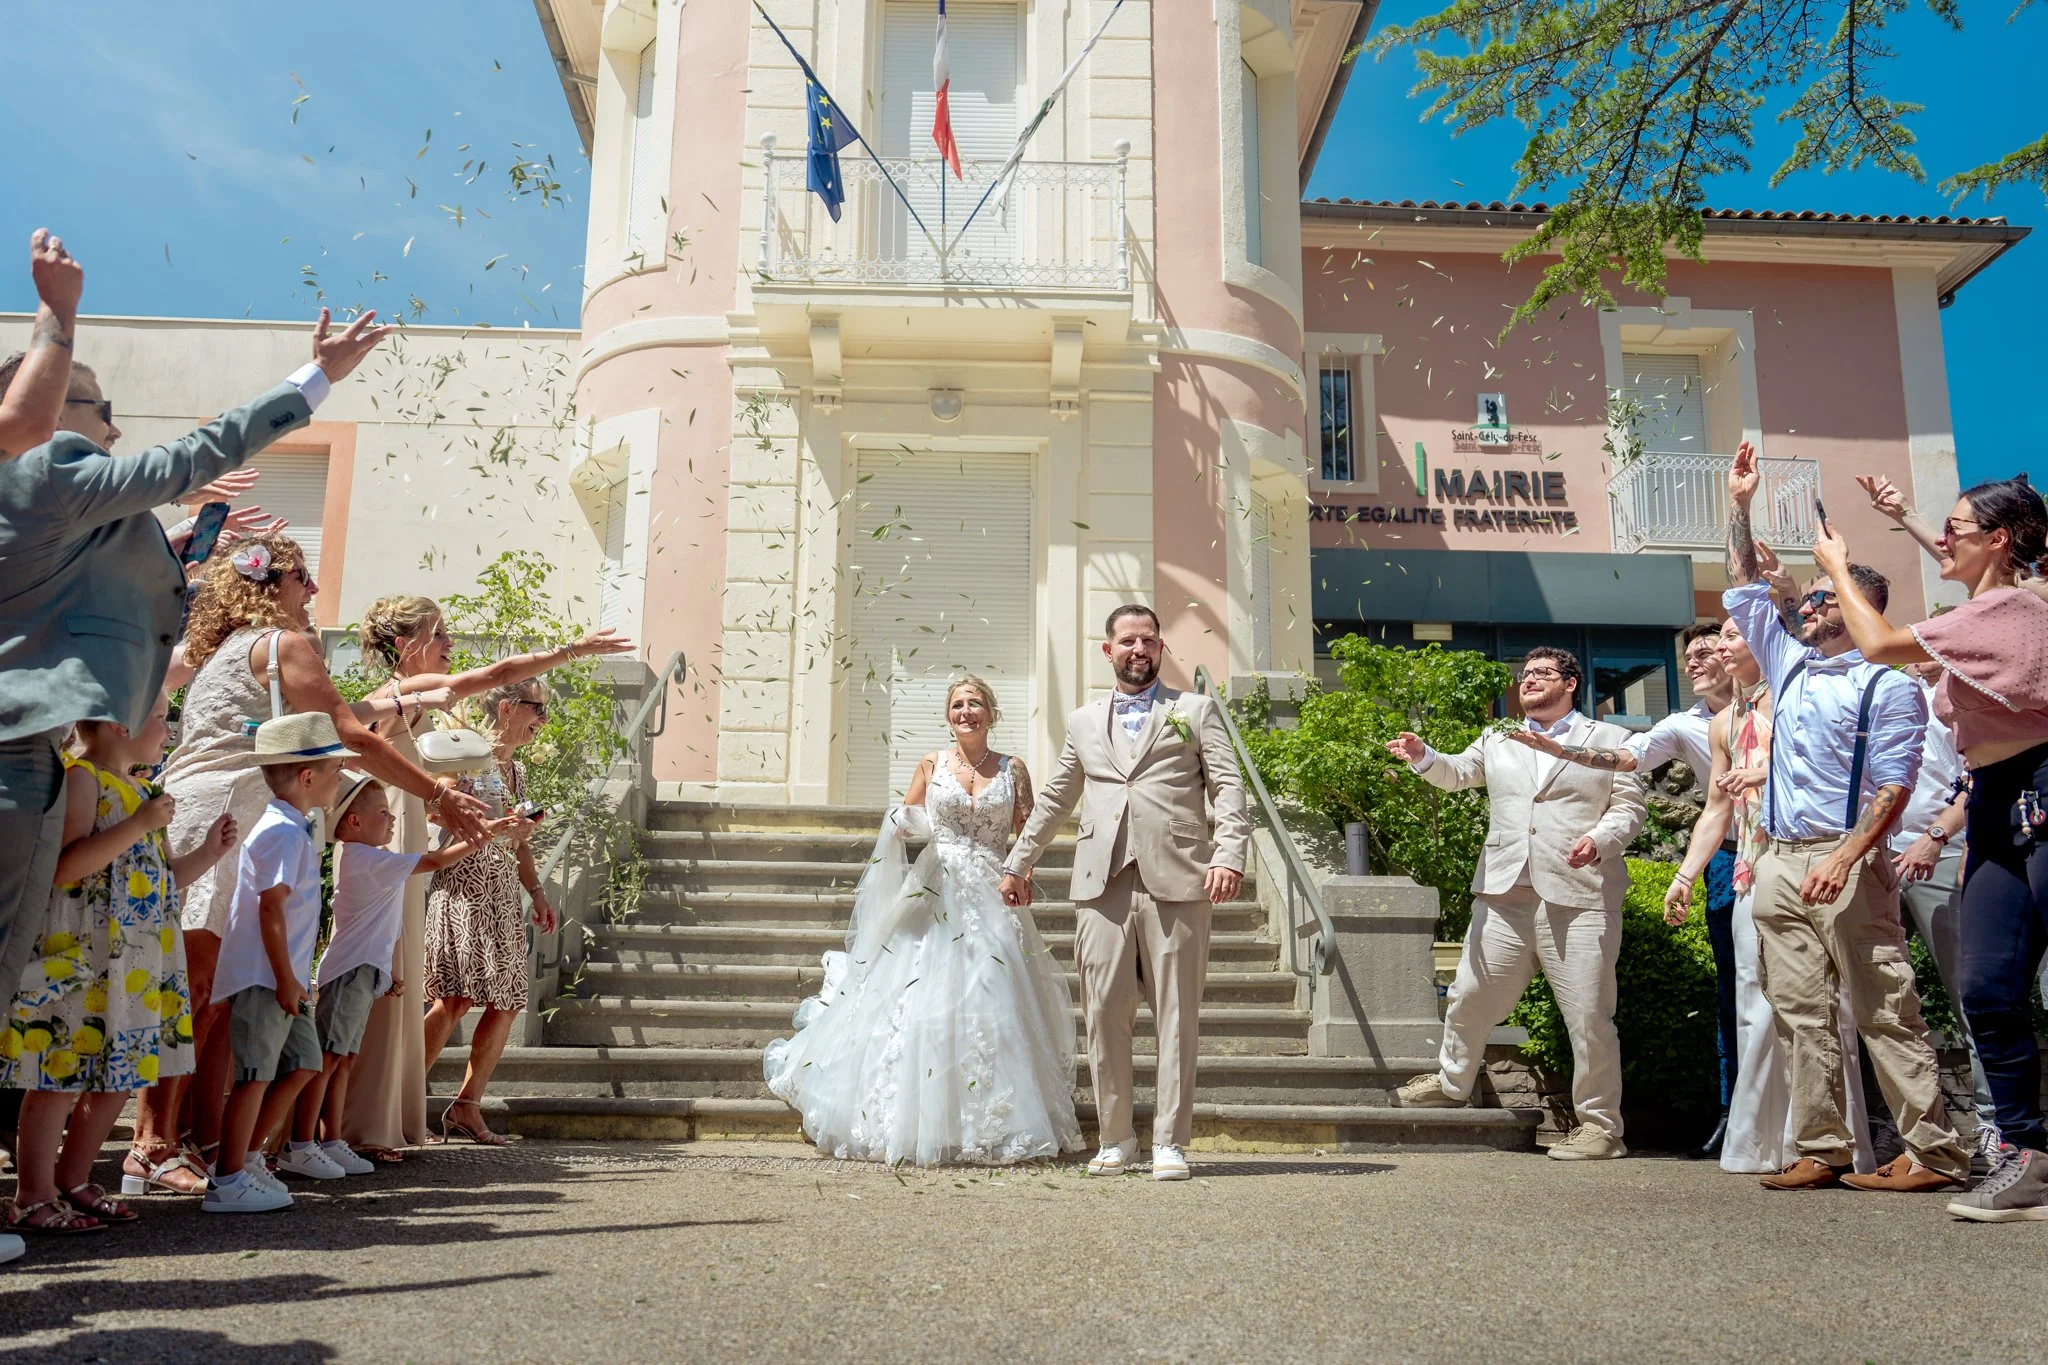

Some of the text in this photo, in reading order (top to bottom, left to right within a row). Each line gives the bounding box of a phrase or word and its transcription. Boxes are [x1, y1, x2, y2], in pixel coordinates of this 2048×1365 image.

[1434, 468, 1566, 501] MAIRIE
[1358, 506, 1444, 525] EGALITE
[1453, 508, 1577, 527] FRATERNITE
